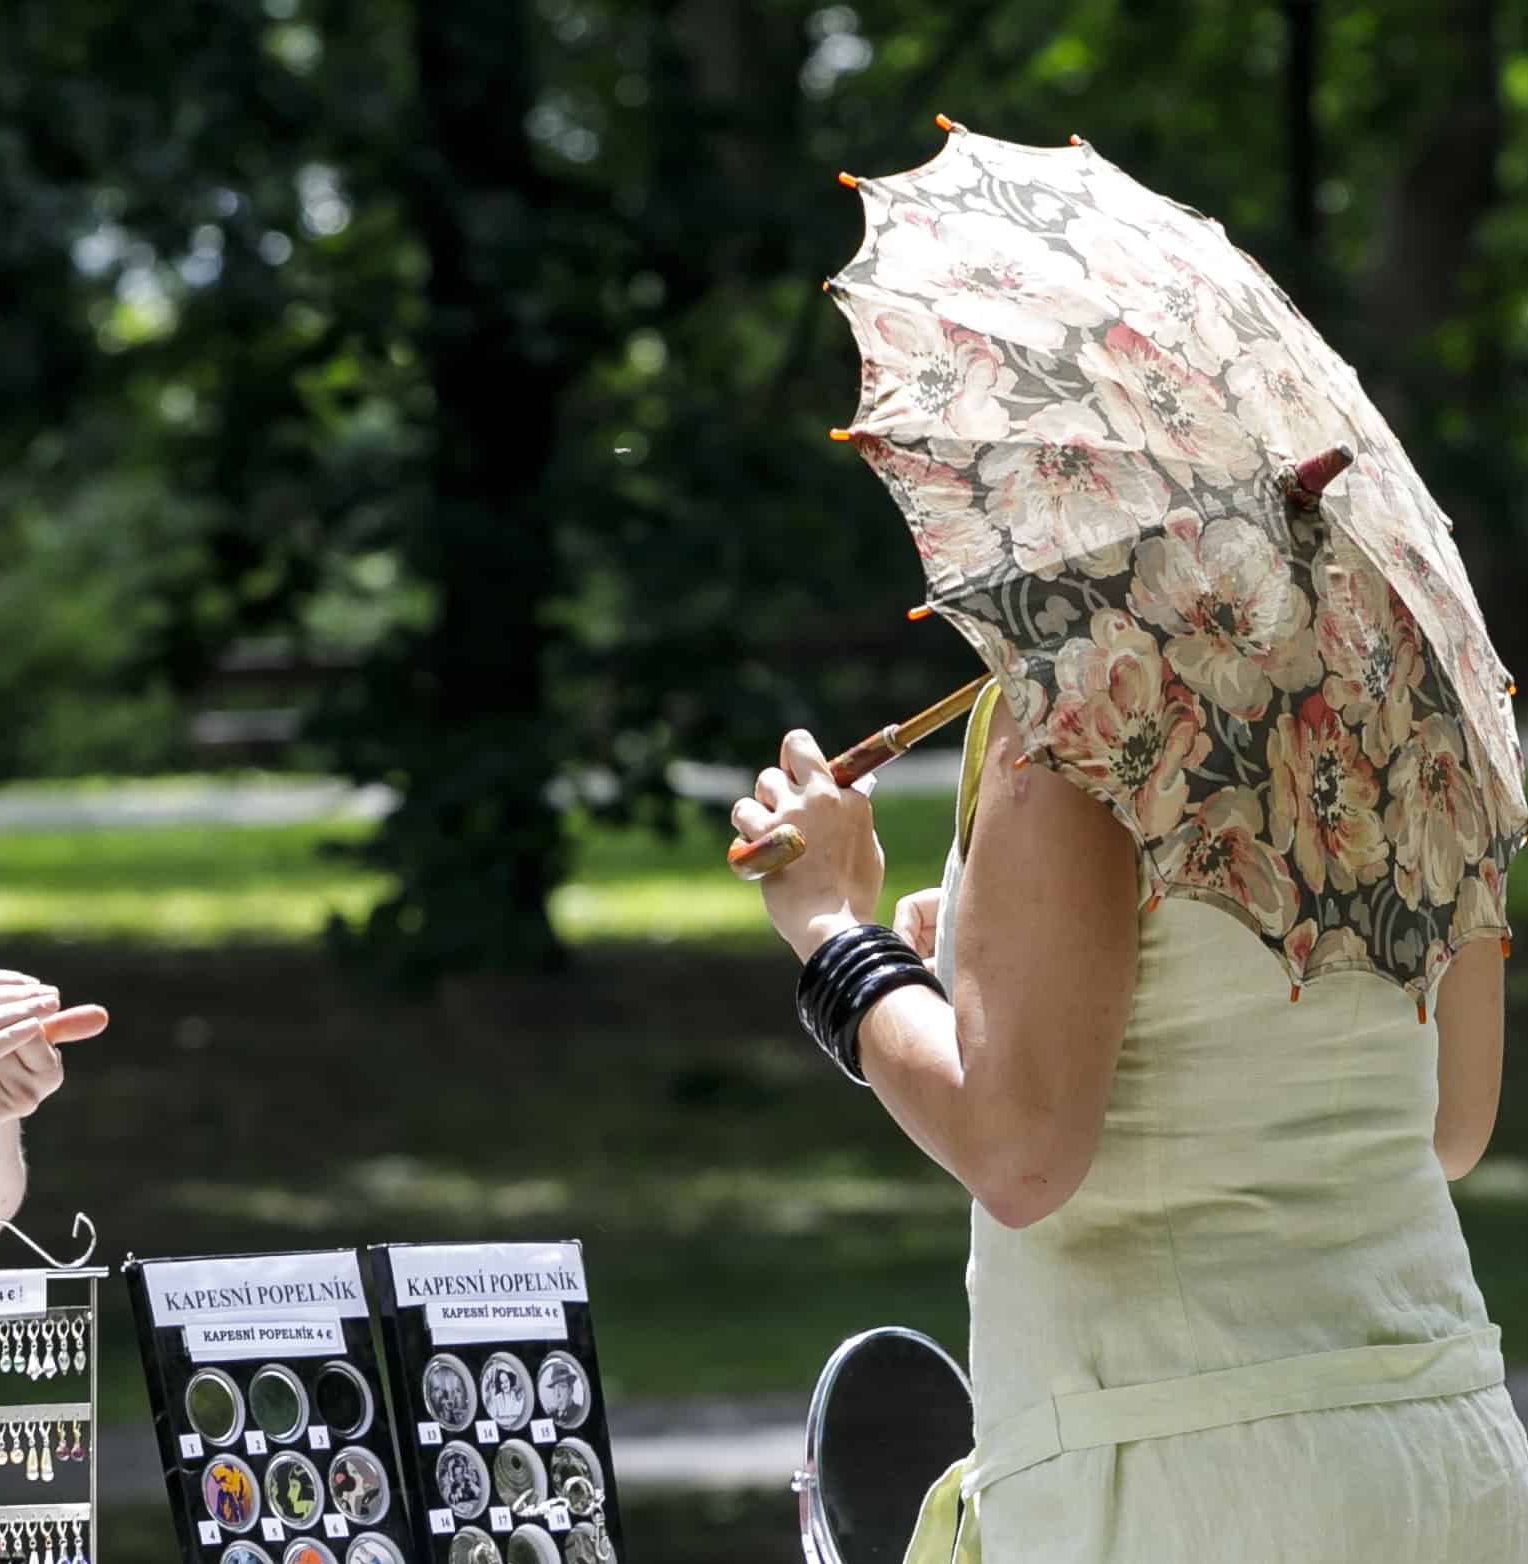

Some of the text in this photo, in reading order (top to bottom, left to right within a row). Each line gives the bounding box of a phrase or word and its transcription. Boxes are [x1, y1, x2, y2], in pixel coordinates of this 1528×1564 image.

[407, 1266, 579, 1297] KAPESNÍ POPELNÍK
[7, 1289, 15, 1300] €
[165, 1276, 356, 1311] KAPESNÍ POPELNÍK
[442, 1305, 489, 1318] KAPESNÍ
[492, 1304, 543, 1317] POPELNÍK
[203, 1326, 255, 1342] KAPESNÍ
[259, 1326, 314, 1340] POPELNÍK
[317, 1329, 323, 1338] 4
[483, 1427, 493, 1438] 14
[209, 1529, 215, 1540] 4
